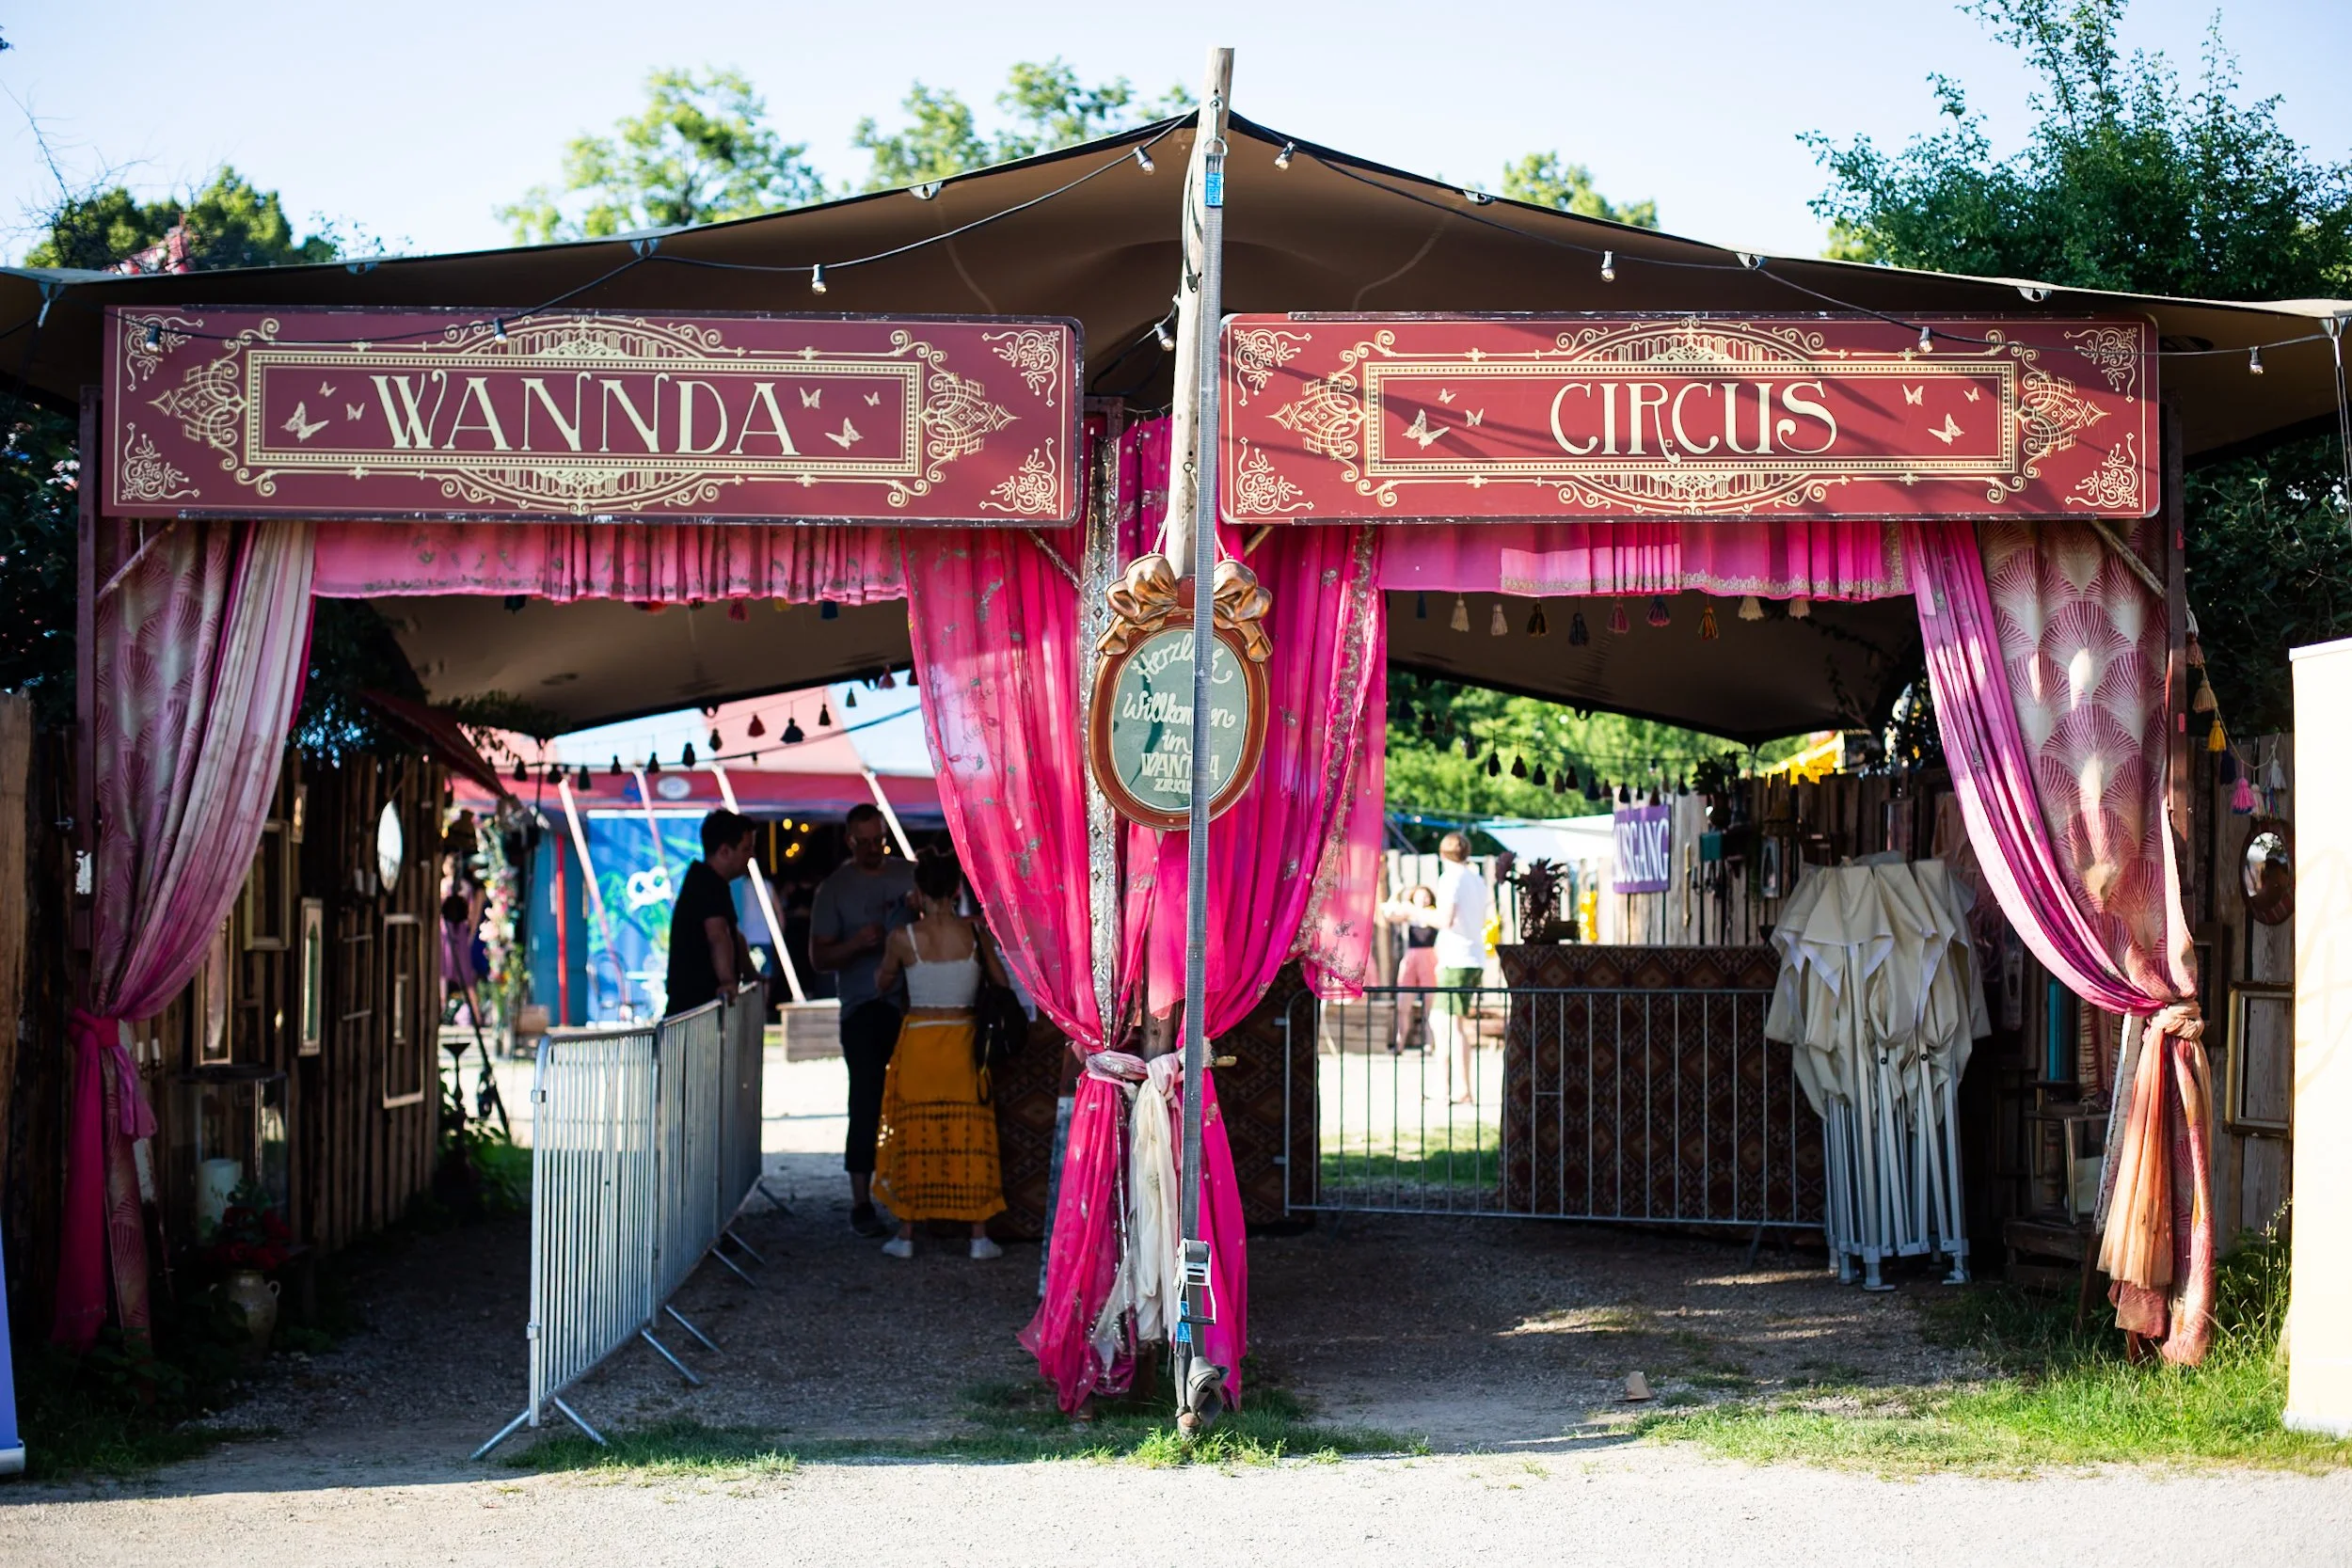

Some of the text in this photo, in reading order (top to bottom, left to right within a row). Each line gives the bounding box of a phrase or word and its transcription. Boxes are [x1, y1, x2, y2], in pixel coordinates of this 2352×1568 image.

[1550, 380, 1838, 465] CIRCUS
[1131, 632, 1233, 684] Herzlh
[1122, 689, 1236, 728] Willkomen
[1161, 729, 1192, 753] im
[1140, 752, 1220, 781] WANA
[1153, 778, 1192, 794] ZIRKU
